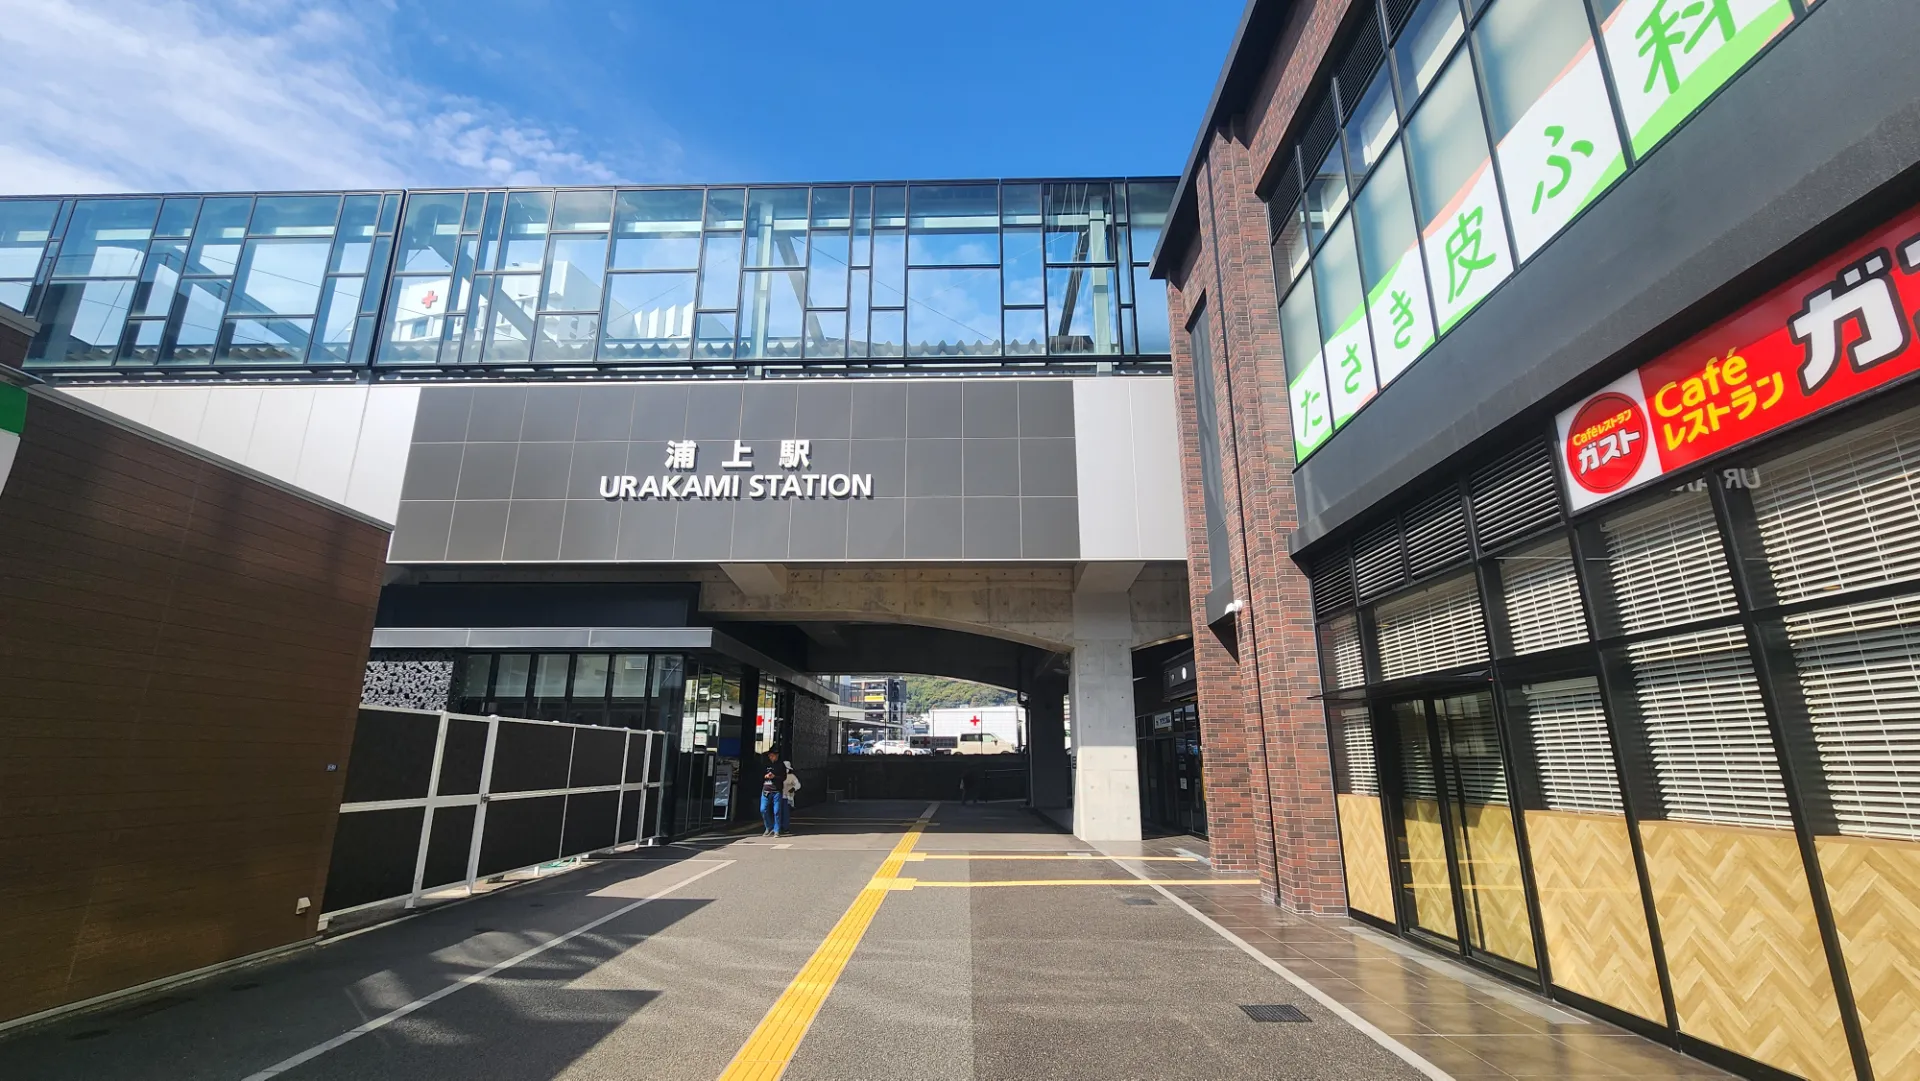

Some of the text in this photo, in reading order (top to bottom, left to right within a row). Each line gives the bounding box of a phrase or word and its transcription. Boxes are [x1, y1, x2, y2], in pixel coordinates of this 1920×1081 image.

[1793, 239, 1920, 390] ガ
[1655, 347, 1748, 417] Café
[1664, 372, 1784, 451] レストラン
[664, 440, 811, 469] 浦上駅
[1578, 428, 1641, 475] ガスト
[600, 474, 872, 498] URAKAMI STATION
